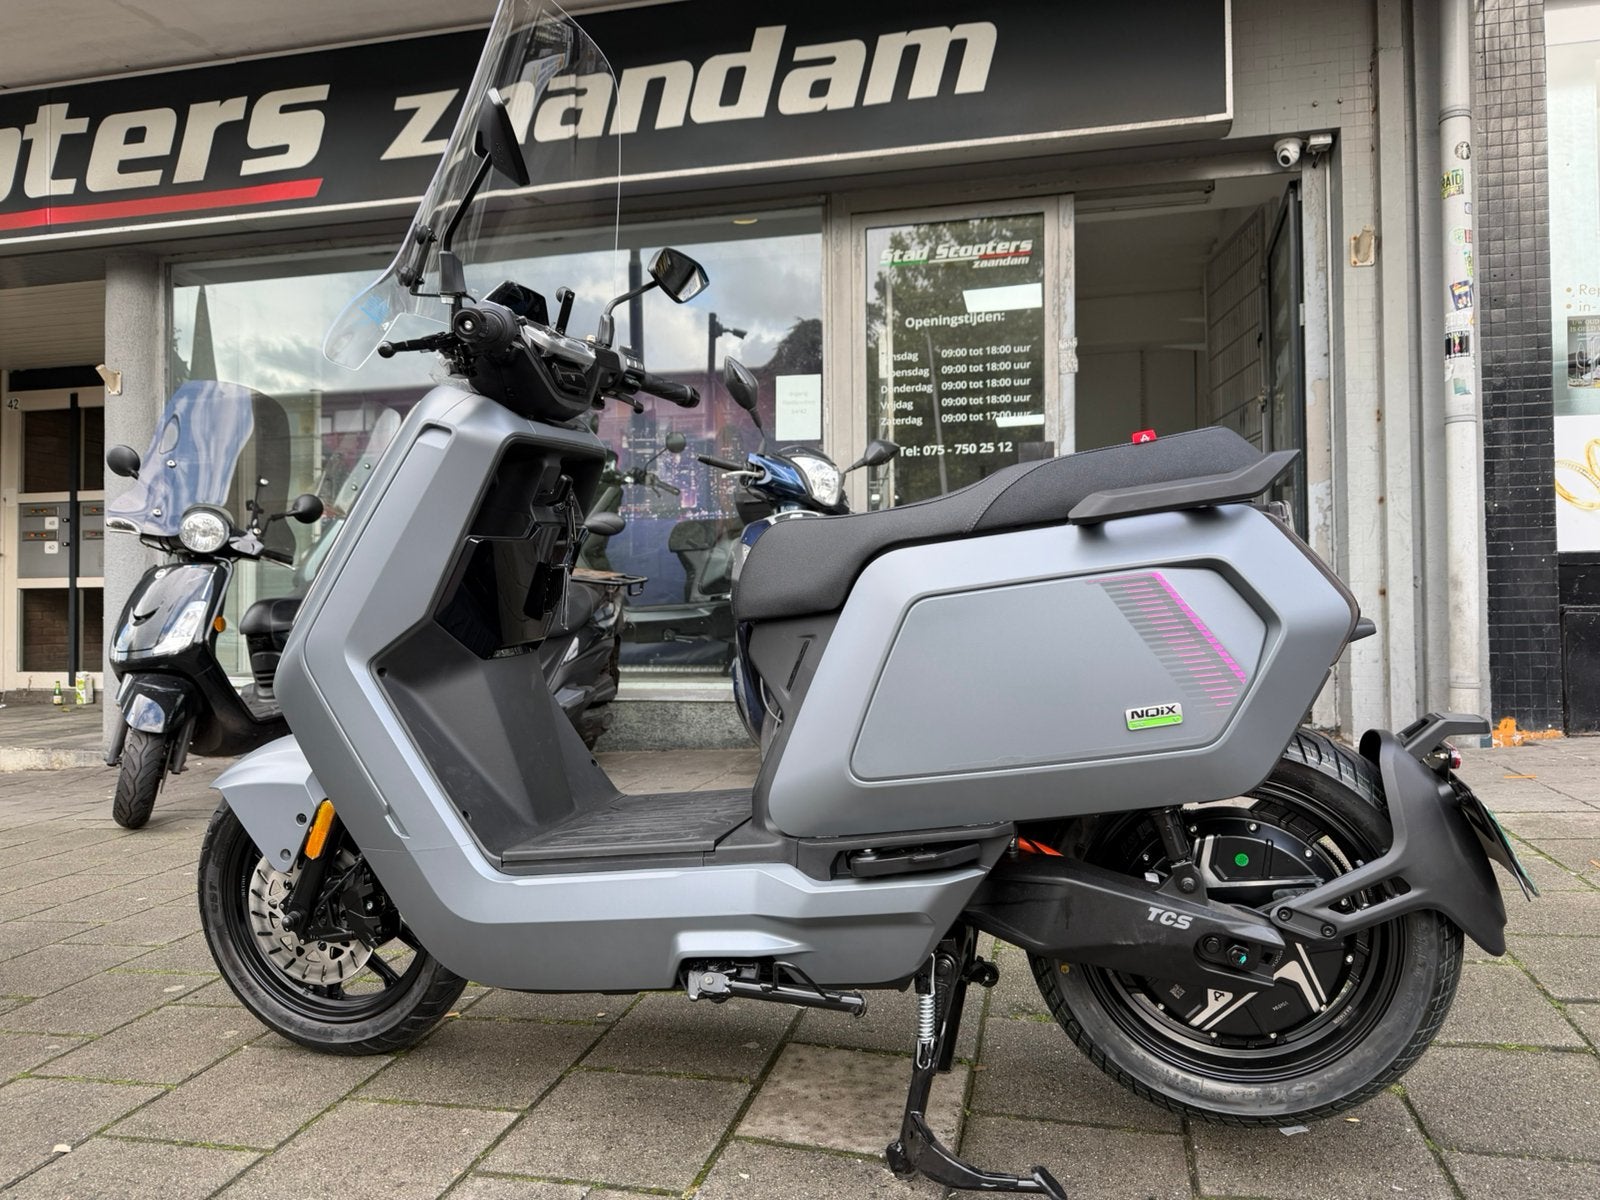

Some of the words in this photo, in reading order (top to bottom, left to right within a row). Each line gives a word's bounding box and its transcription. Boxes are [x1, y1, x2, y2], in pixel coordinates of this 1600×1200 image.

[880, 246, 930, 263] Stad
[935, 239, 1033, 260] Scooters
[972, 256, 1030, 269] zaandam
[1578, 283, 1600, 297] Re
[904, 311, 1006, 330] Openingstijden:
[941, 347, 968, 358] 09:00
[969, 347, 984, 356] tot
[985, 344, 1012, 355] 18:00
[1013, 344, 1032, 353] uur
[885, 366, 930, 378] oensdag
[941, 364, 968, 374] 09:00
[969, 363, 984, 373] tot
[985, 361, 1012, 372] 18:00
[1013, 361, 1032, 370] uur
[880, 383, 933, 394] Dnderdag
[941, 380, 968, 391] 09:00
[969, 380, 984, 389] tot
[985, 378, 1012, 388] 18:00
[1013, 377, 1032, 386] uur
[7, 398, 19, 410] 42
[880, 400, 914, 411] Vjdag
[941, 397, 968, 407] 09:00
[969, 396, 984, 405] tot
[985, 394, 1012, 404] 18:00
[1013, 394, 1032, 403] uur
[880, 415, 923, 427] Zterdag
[941, 413, 968, 423] 09:00
[969, 412, 984, 422] tot
[985, 410, 1011, 421] 17:00
[900, 445, 920, 457] Tel:
[922, 444, 945, 456] 075
[954, 443, 977, 455] 750
[979, 442, 995, 453] 25
[997, 441, 1013, 453] 12
[1147, 906, 1194, 930] TCS
